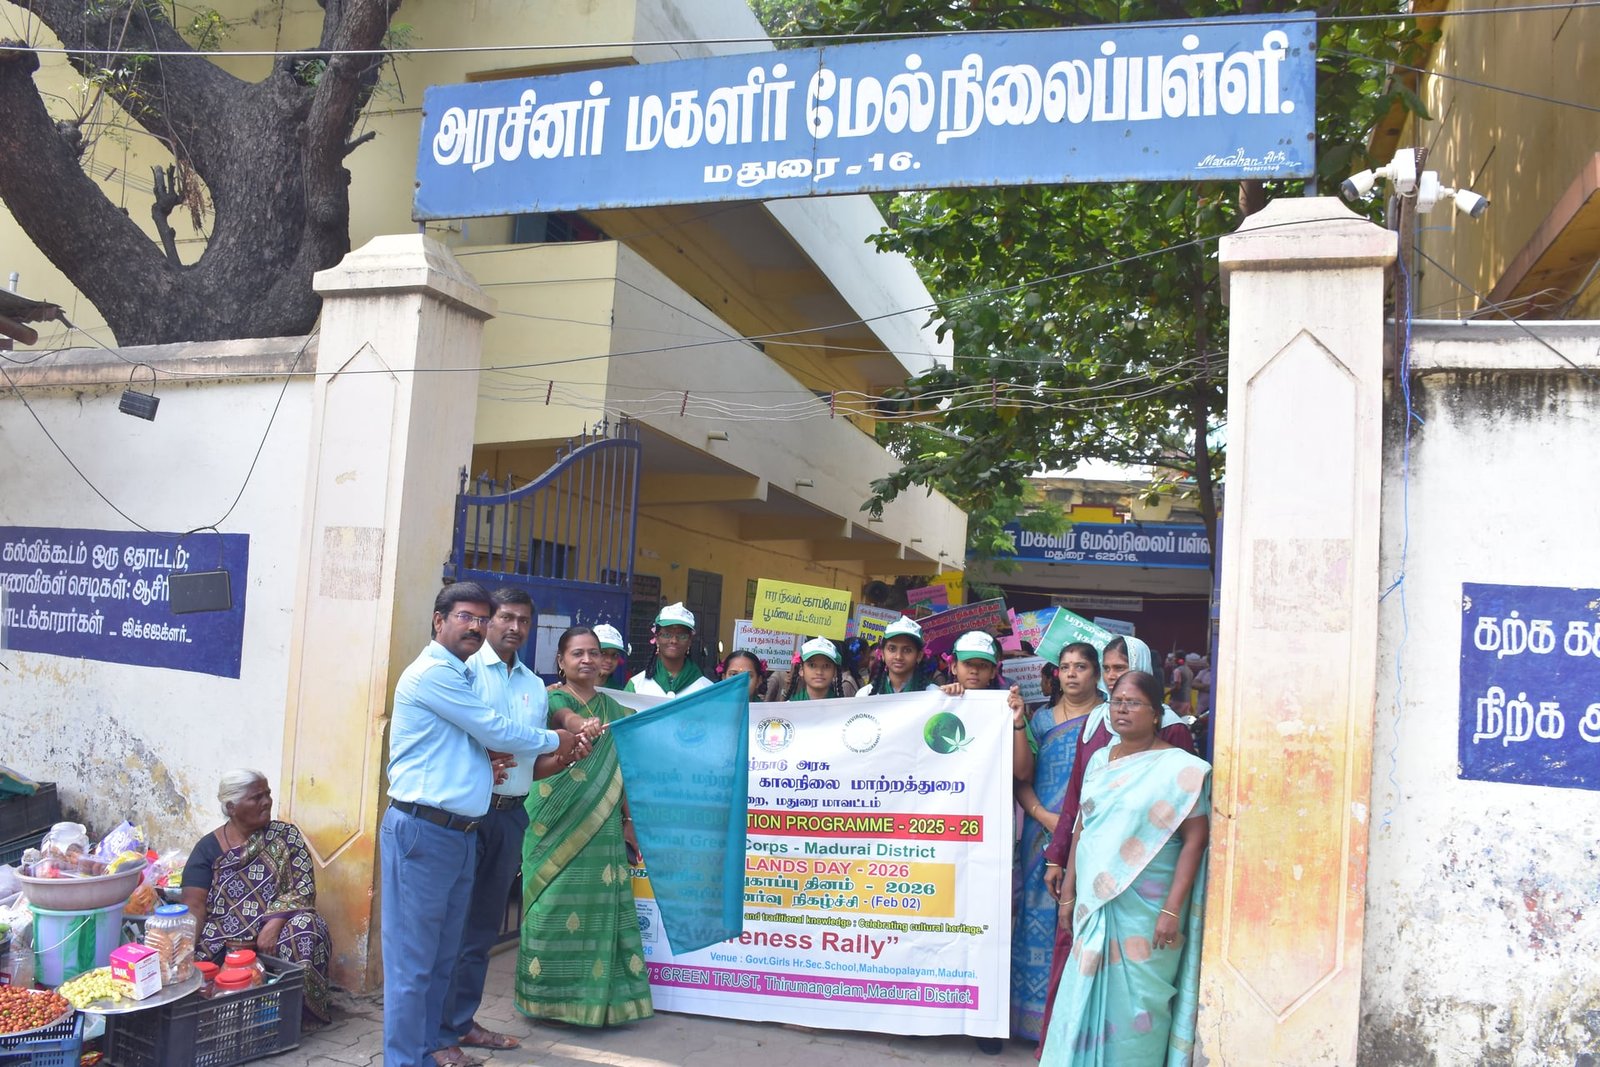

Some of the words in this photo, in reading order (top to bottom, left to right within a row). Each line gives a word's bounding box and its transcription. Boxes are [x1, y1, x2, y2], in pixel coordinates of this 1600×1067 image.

[433, 81, 610, 173] அரசினர்
[625, 63, 795, 152] மகளிர்
[704, 158, 840, 188] மதுரை
[3, 538, 87, 564] கல்விக்கூடம்
[92, 544, 119, 571] ஒரு
[1474, 610, 1556, 659] கற்க
[1472, 686, 1565, 748] நிற்க
[796, 760, 830, 772] அரசு
[759, 774, 840, 792] காலநிலை
[851, 775, 965, 795] மாற்றத்துறை
[776, 798, 819, 809] மதுரை
[822, 797, 881, 808] மாவட்டம்
[786, 815, 894, 832] PROGRAMME
[908, 818, 945, 834] 2025
[959, 820, 979, 835] 26
[804, 841, 870, 855] Madurai
[876, 843, 936, 858] District
[814, 861, 851, 875] DAY
[868, 863, 909, 878] 2026
[804, 876, 854, 891] தினம்
[885, 882, 936, 895] 2026
[792, 893, 858, 909] நிகழ்ச்சி
[871, 895, 898, 909] (Feb
[902, 897, 921, 911] 02)
[744, 912, 760, 921] and
[762, 913, 804, 924] traditional
[806, 914, 852, 928] knowledge
[858, 918, 908, 933] Celebrating
[910, 922, 944, 932] cultural
[710, 952, 737, 963] Venue
[661, 967, 709, 985] GREEN
[713, 971, 761, 991] TRUST,
